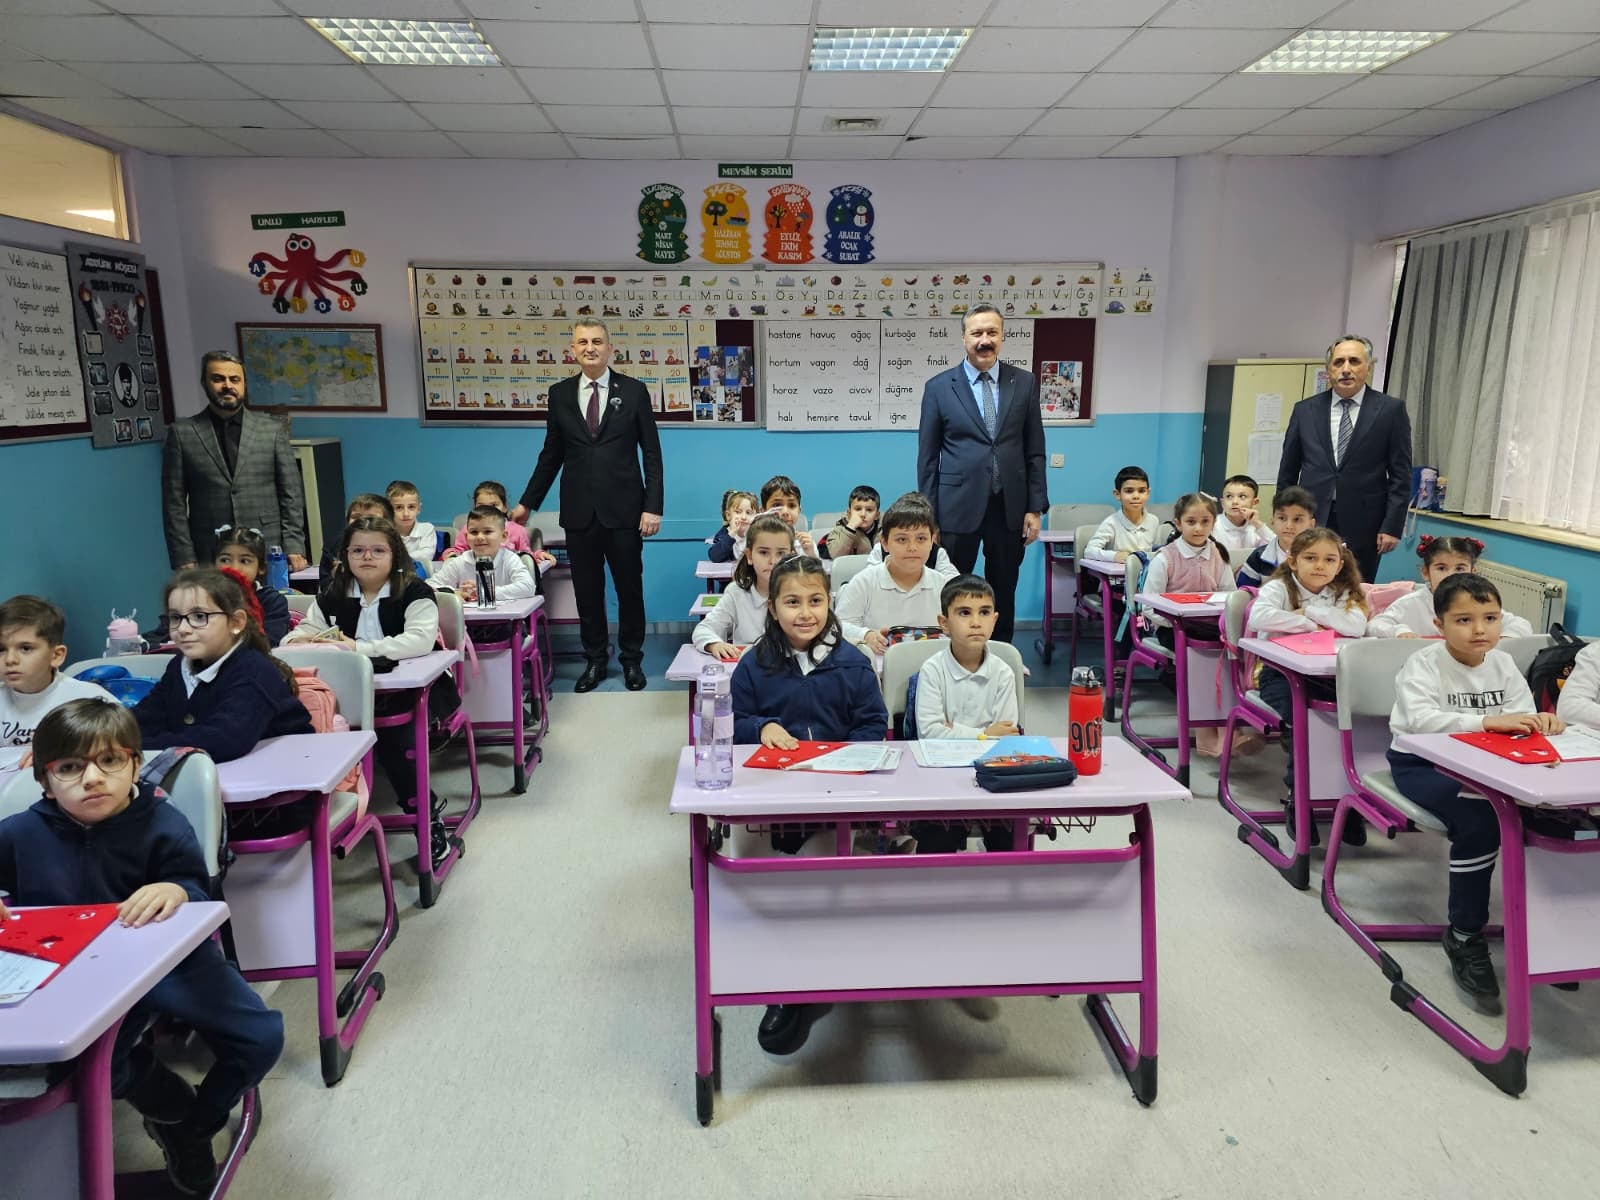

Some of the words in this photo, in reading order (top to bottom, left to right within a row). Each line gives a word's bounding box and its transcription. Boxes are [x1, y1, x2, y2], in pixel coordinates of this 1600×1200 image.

[768, 328, 801, 339] hastane
[810, 328, 836, 340] havuç
[850, 330, 872, 343] ağaç
[885, 328, 916, 341] kurbağa
[1002, 327, 1031, 342] jderha
[769, 355, 801, 367] hortum
[809, 360, 836, 371] vagon
[853, 354, 869, 371] dağ
[887, 357, 912, 369] soğan
[671, 369, 680, 377] 20
[773, 384, 798, 394] horoz
[885, 383, 913, 397] düğme
[778, 410, 793, 422] halı
[849, 410, 872, 421] tavuk
[889, 413, 907, 424] iğne
